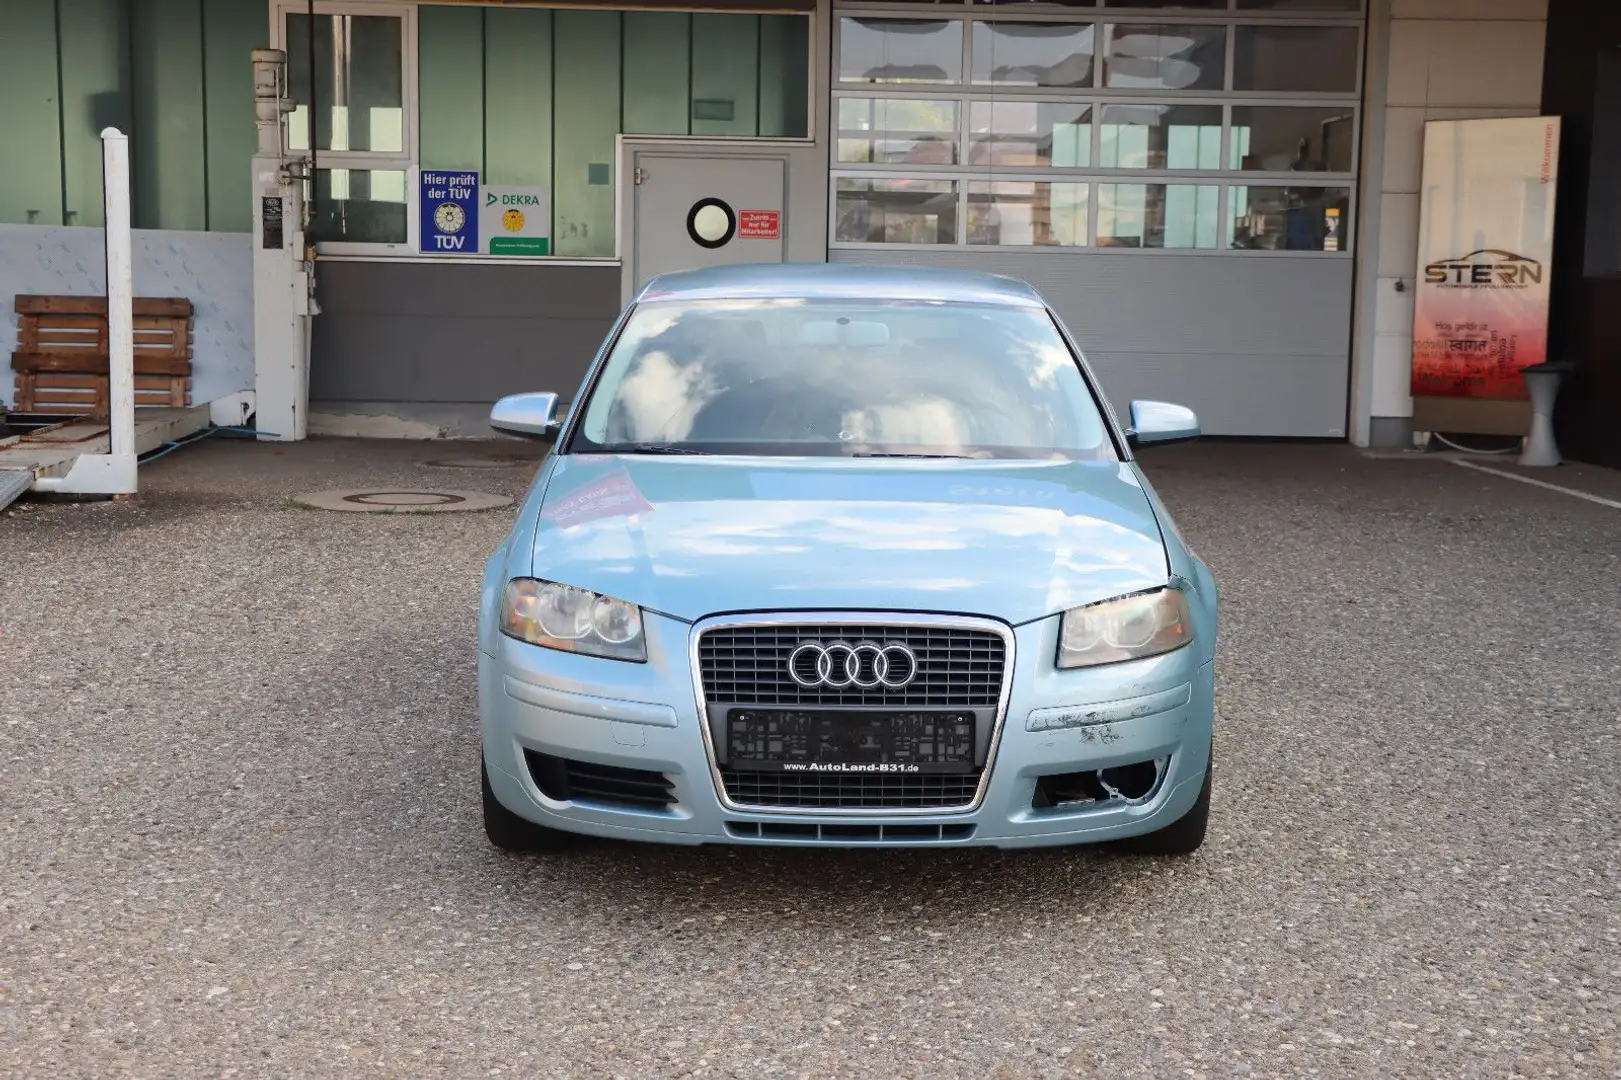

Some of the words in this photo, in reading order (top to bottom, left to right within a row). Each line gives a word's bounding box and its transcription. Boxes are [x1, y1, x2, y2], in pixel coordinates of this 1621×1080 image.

[424, 173, 447, 185] Hier
[449, 174, 475, 187] prüft
[428, 188, 445, 199] der
[448, 186, 471, 199] TÜV
[502, 194, 540, 205] DEKRA
[434, 235, 465, 249] TÜV
[1425, 264, 1542, 284] STERN
[783, 762, 919, 772] www.AutoLand-B31.de
